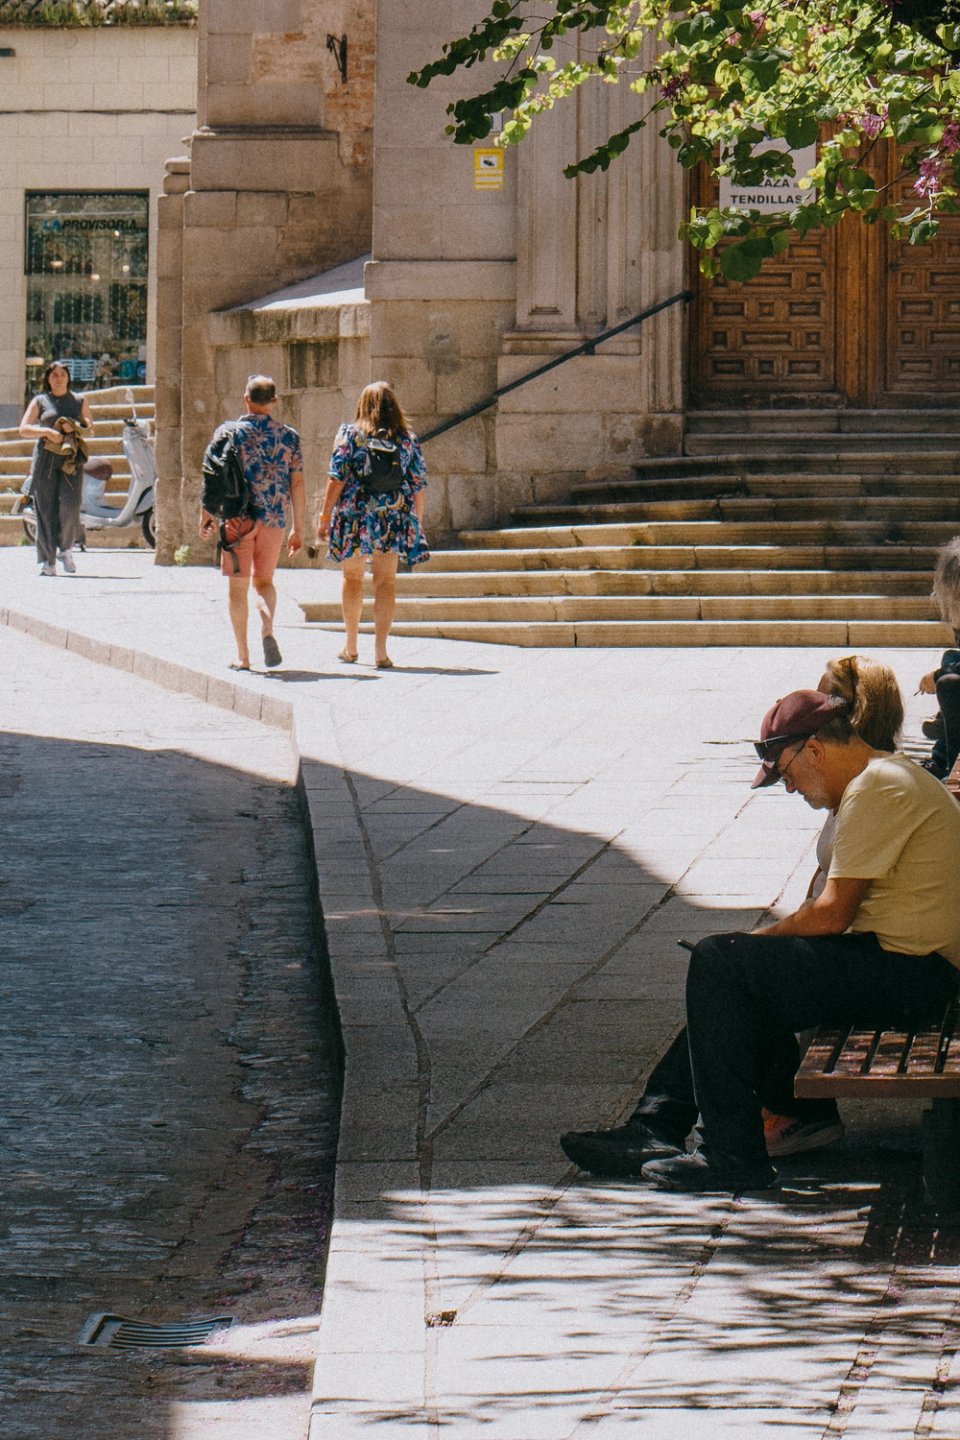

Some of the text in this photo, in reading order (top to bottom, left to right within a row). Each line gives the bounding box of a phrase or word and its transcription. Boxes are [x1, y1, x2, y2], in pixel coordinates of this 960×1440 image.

[730, 195, 802, 204] TENDILLAS
[43, 219, 138, 230] LA PROVISORIA
